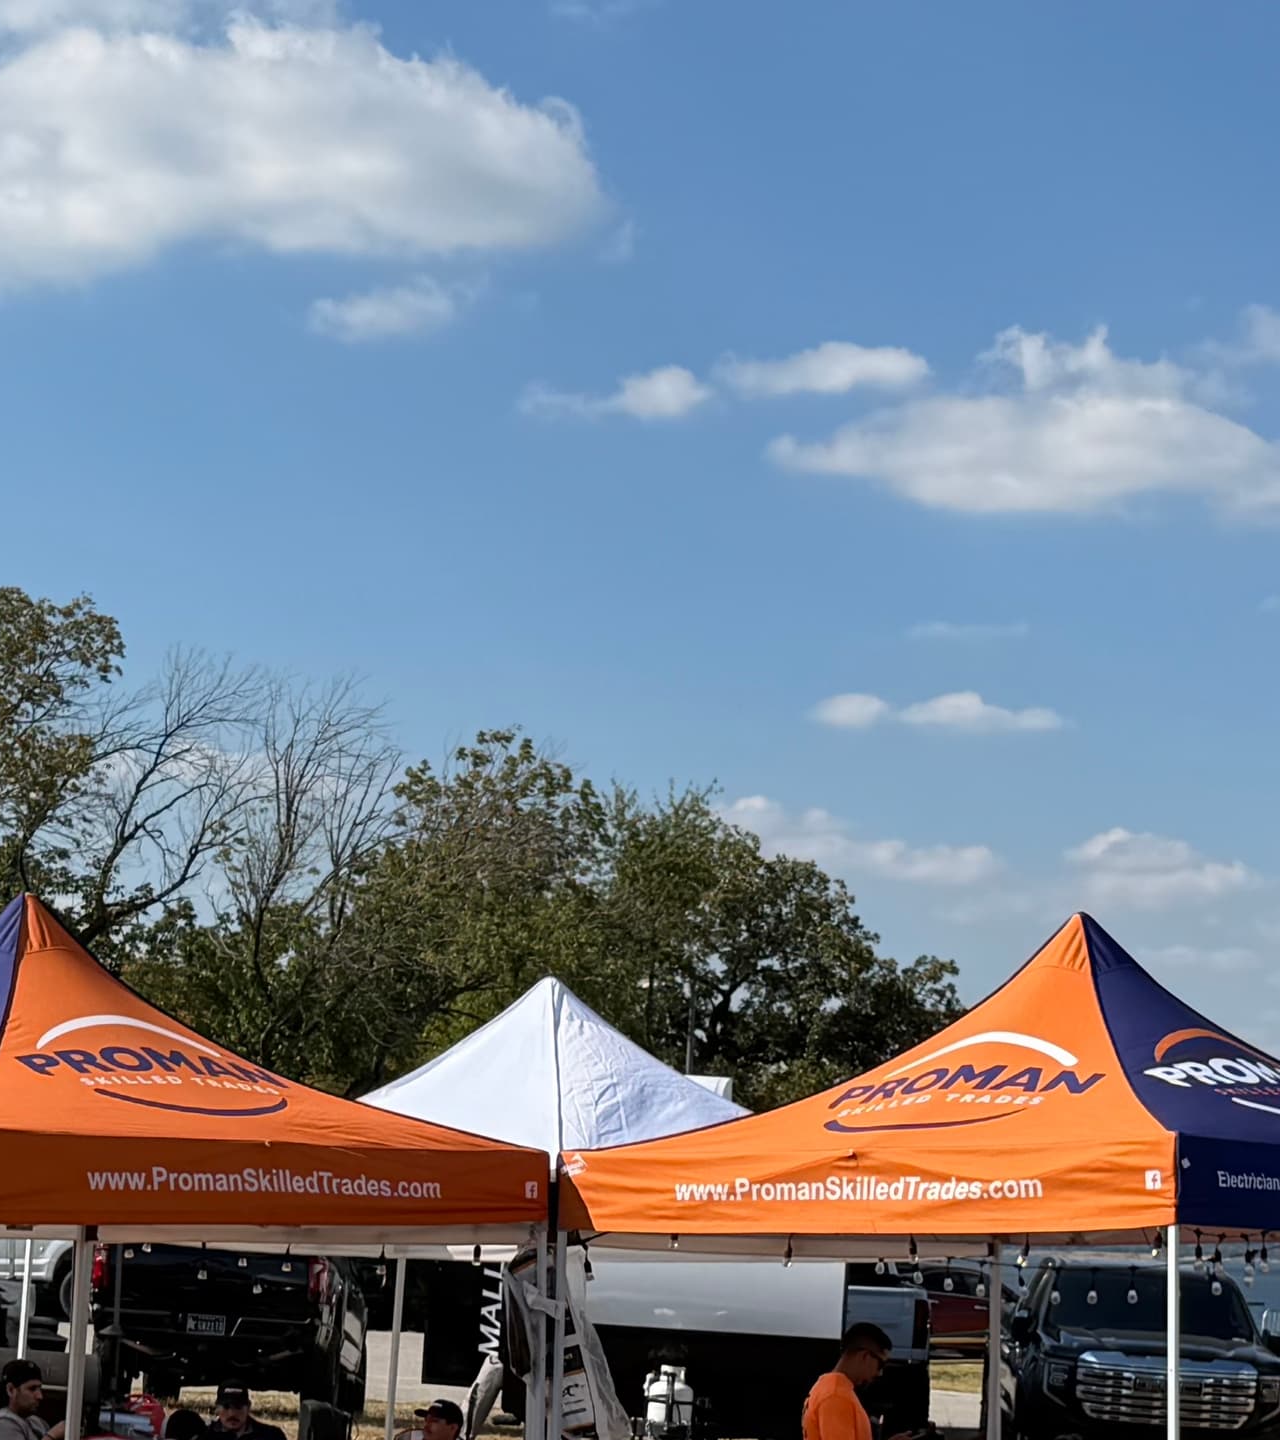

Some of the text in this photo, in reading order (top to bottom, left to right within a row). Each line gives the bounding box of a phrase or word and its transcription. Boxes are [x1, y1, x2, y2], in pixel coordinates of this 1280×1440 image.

[15, 1046, 289, 1089] PROMAN
[79, 1075, 281, 1096] SKILLED TRADES
[828, 1064, 1107, 1110] PROMAN
[837, 1093, 1046, 1118] SKILLED TRADES
[87, 1166, 442, 1200] www.PromanSkilledTrades.com
[674, 1177, 1043, 1202] www.PromanSkilledTrades.com
